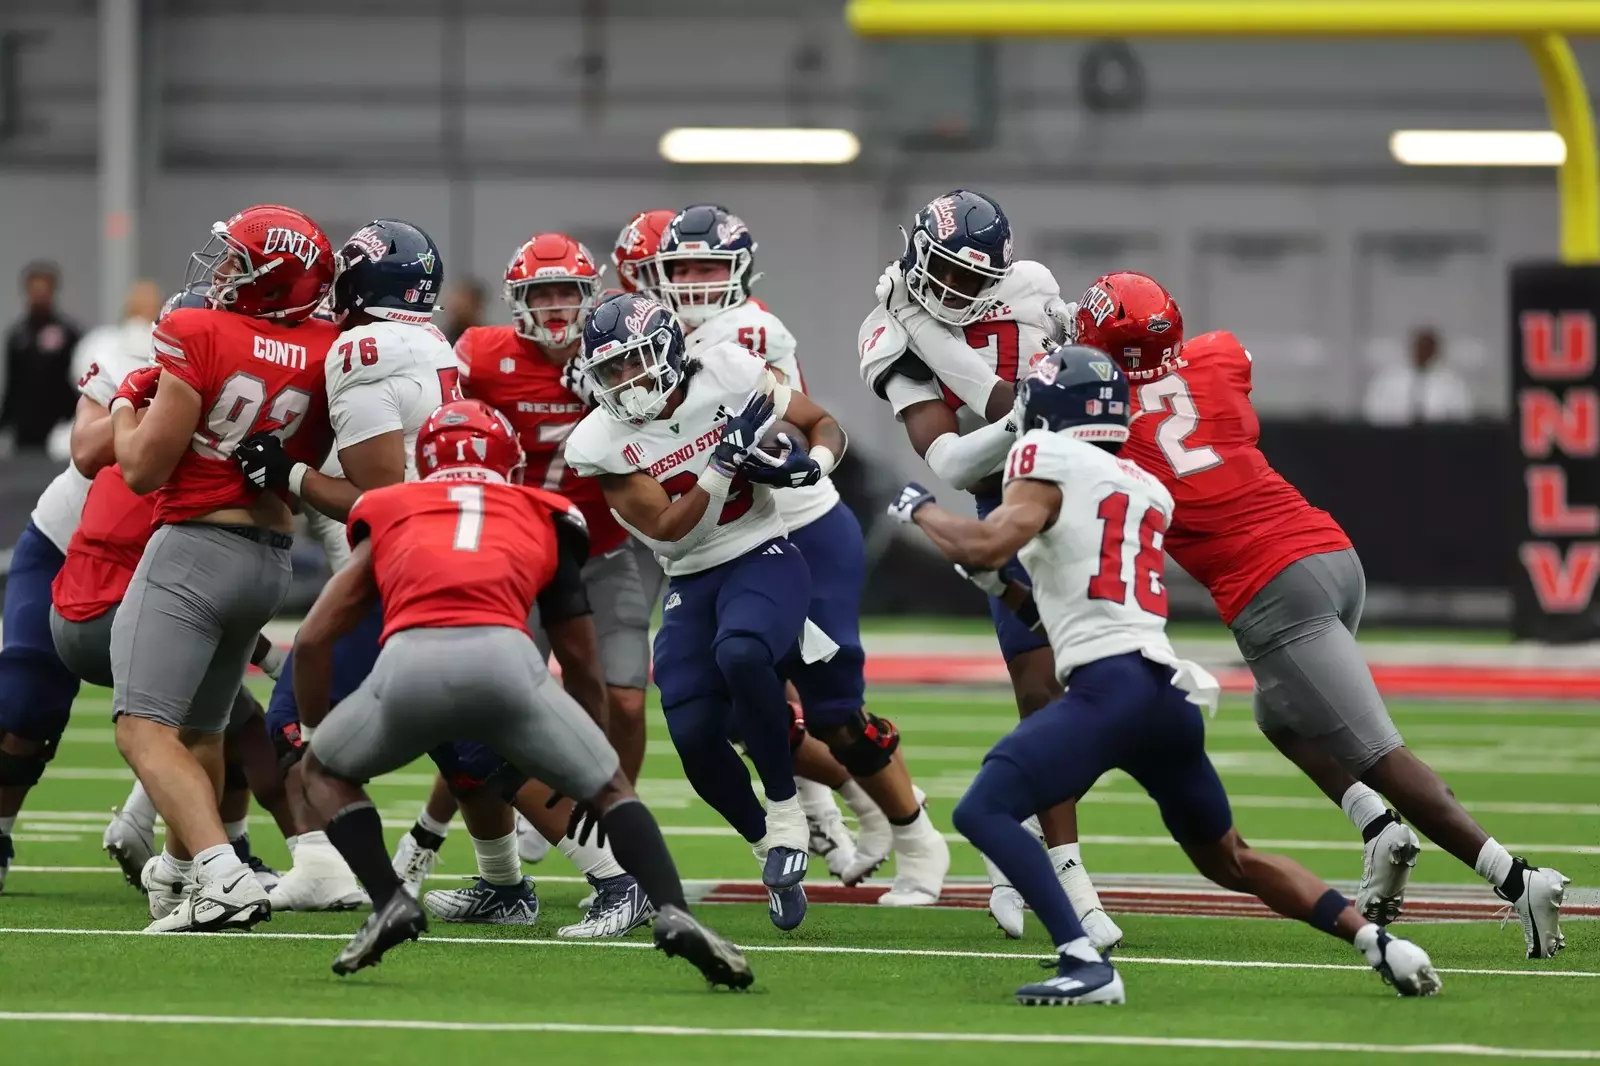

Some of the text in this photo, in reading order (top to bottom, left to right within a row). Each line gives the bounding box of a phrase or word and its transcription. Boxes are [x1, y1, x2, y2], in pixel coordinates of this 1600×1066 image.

[263, 227, 321, 271] UNLV
[418, 280, 433, 290] 76
[253, 335, 307, 370] CONTI
[338, 337, 378, 373] 76
[738, 327, 766, 354] 51
[1099, 387, 1113, 399] 18
[1137, 371, 1223, 478] 2
[1008, 444, 1038, 478] 18
[1519, 309, 1600, 613] UNLV
[447, 484, 485, 553] 1
[1088, 491, 1168, 618] 18
